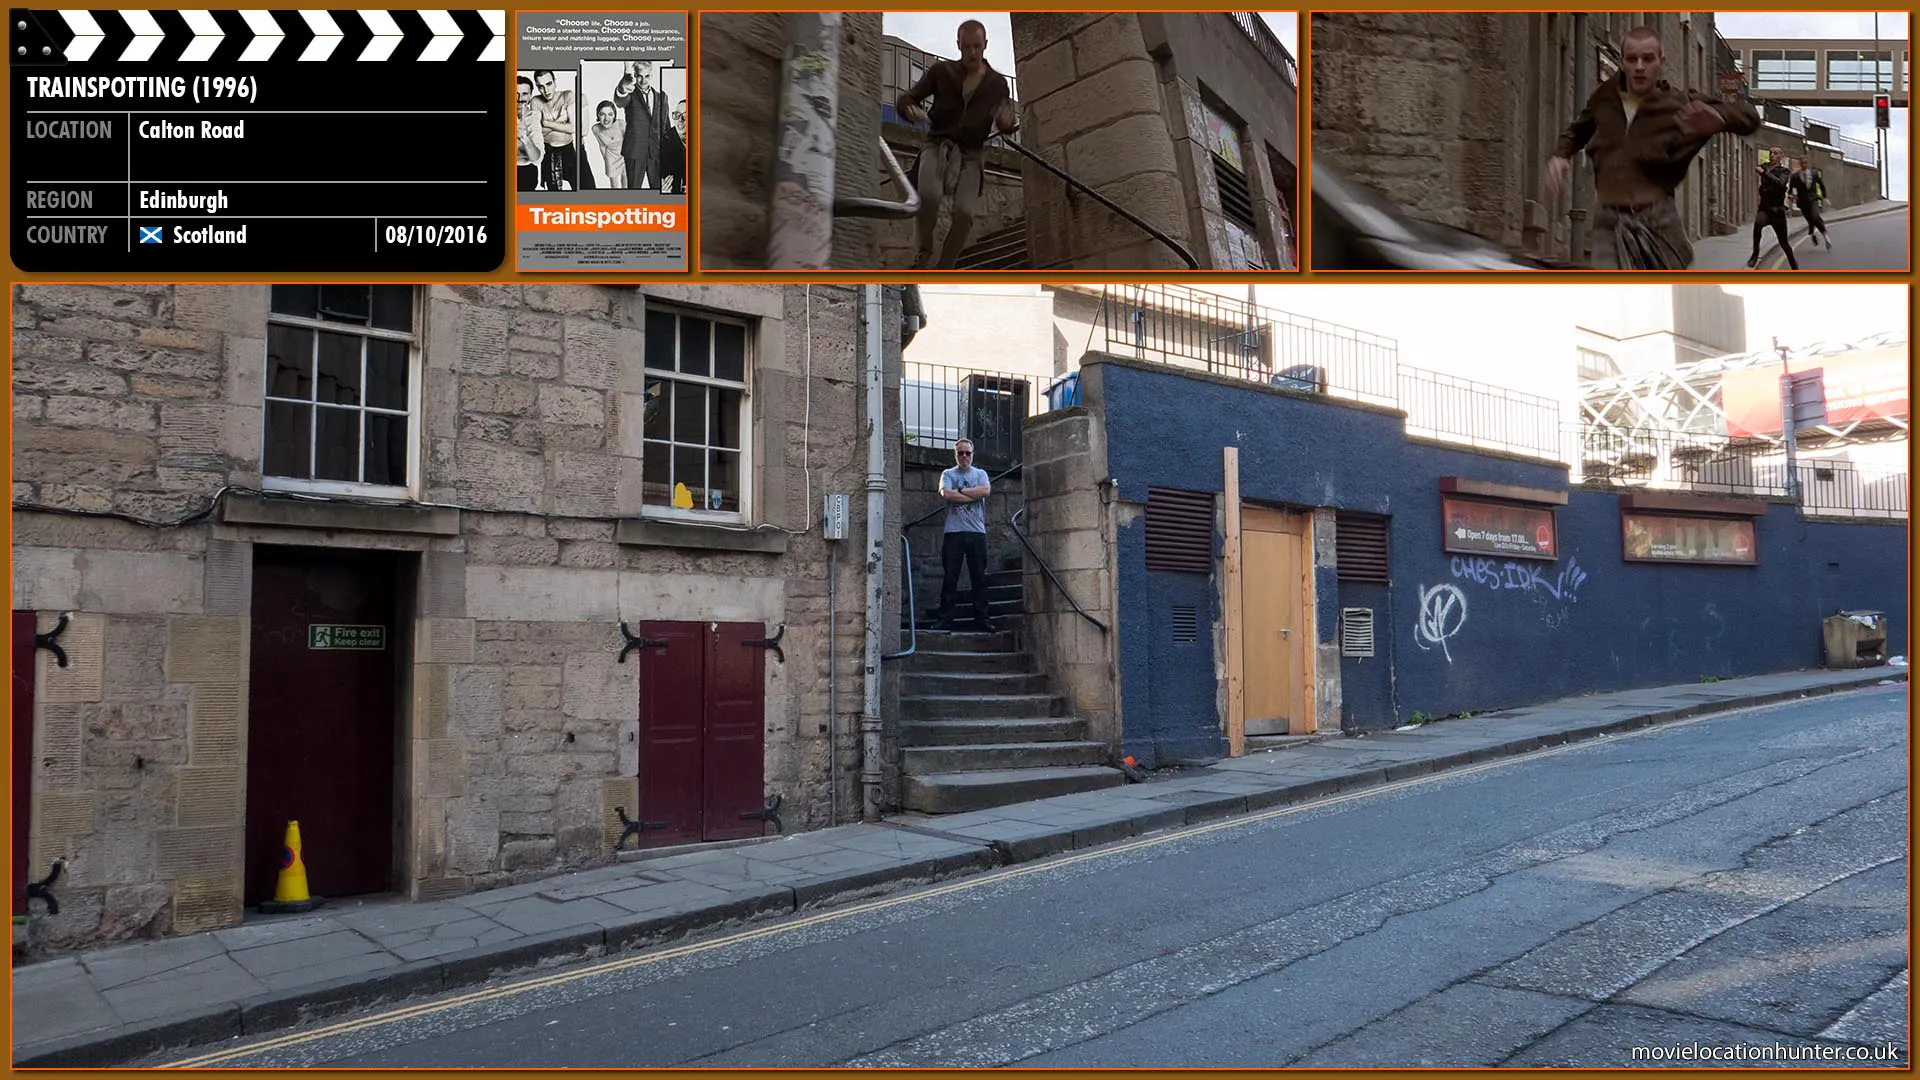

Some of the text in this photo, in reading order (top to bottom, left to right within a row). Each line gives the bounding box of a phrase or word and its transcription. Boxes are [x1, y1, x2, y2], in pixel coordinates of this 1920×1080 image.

[529, 208, 675, 228] Trainspotting
[1467, 529, 1481, 541] Open
[1486, 531, 1497, 542] days
[1498, 532, 1511, 542] from
[335, 627, 380, 637] Fire exit
[359, 638, 380, 646] clear
